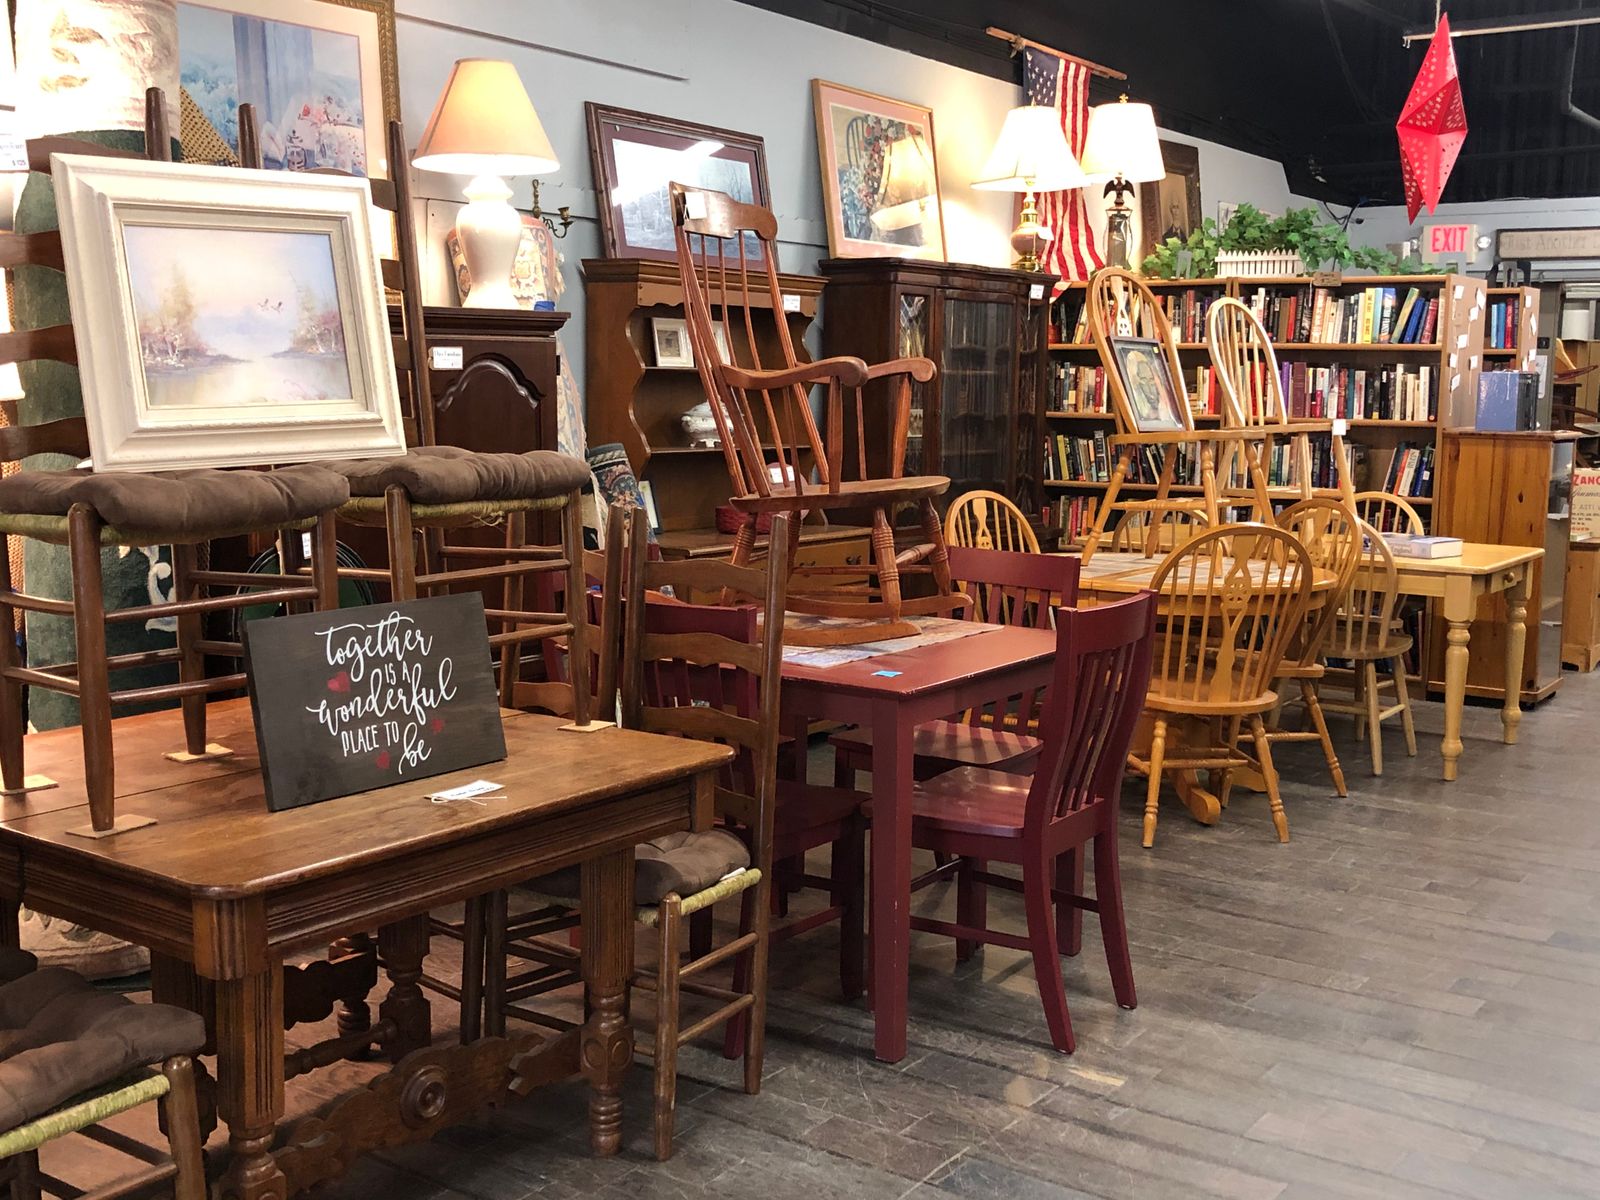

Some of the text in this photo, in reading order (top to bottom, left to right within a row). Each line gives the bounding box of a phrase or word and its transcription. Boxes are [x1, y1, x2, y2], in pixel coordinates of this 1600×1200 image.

[1432, 227, 1467, 252] EXIT
[384, 660, 412, 686] IS A
[341, 720, 400, 758] PLACE TO
[398, 721, 432, 775] be
